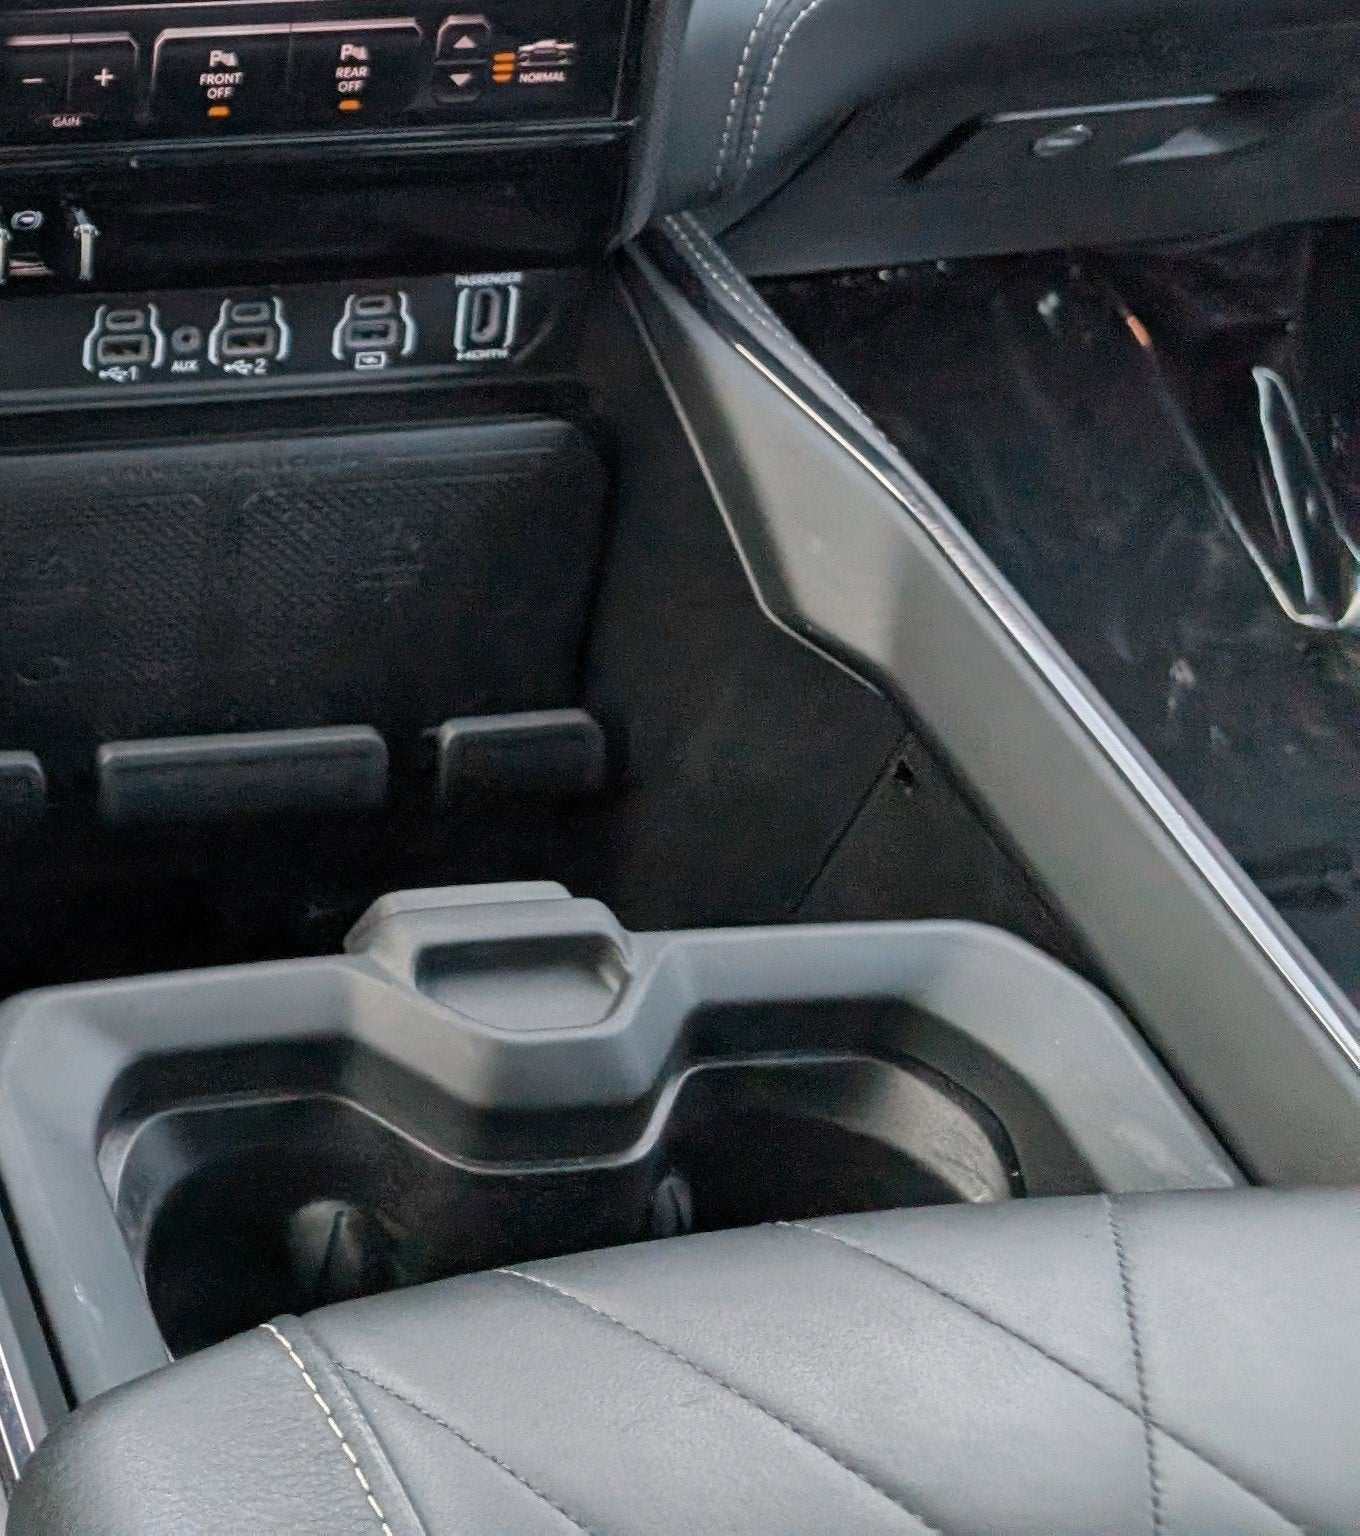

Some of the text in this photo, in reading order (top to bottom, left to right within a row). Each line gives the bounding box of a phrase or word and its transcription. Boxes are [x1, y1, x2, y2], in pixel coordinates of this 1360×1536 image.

[199, 71, 244, 86] FRONT
[335, 66, 370, 79] REAR
[518, 71, 566, 84] NORMAL
[337, 80, 365, 93] OFF
[206, 87, 233, 100] OFF
